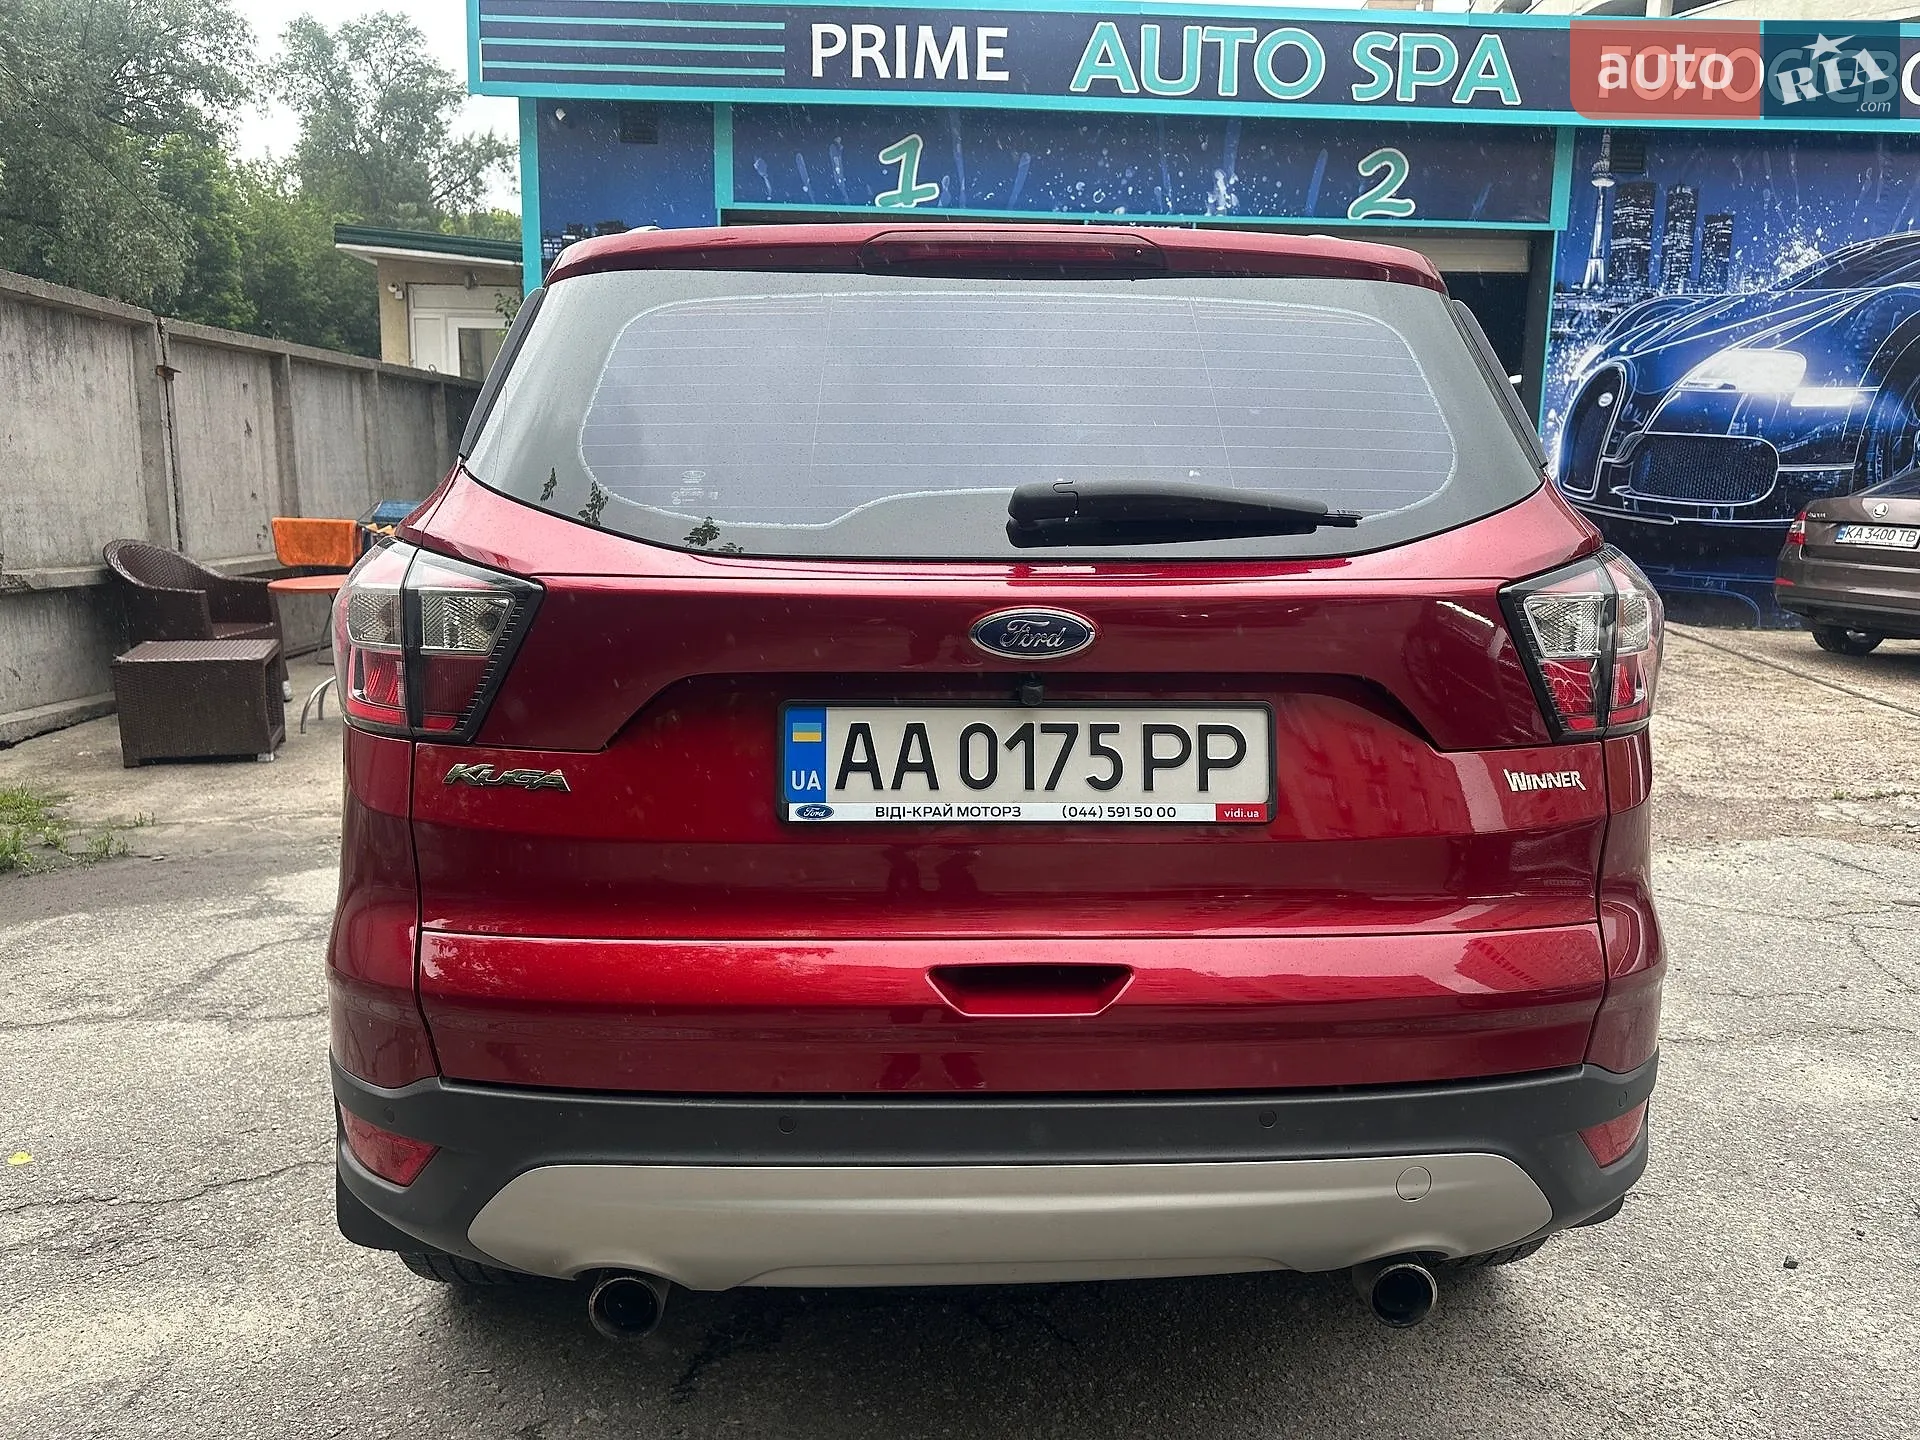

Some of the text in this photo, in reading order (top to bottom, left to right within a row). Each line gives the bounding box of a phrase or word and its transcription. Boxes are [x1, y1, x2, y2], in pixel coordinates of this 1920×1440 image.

[811, 21, 1521, 106] PRIME AUTO SPA
[876, 133, 940, 208] 1
[1347, 147, 1416, 220] 2
[1845, 526, 1862, 539] KA
[1865, 527, 1896, 540] 3400
[1899, 530, 1917, 543] TB
[1000, 619, 1066, 649] Ford
[834, 721, 1248, 792] AA 0175 PP
[791, 770, 821, 790] UA
[803, 806, 826, 818] Ford
[875, 803, 1022, 819] ВІДІ-КРАЙ МОТОРЗ
[1061, 805, 1177, 819] (044) 591 50 00
[1223, 807, 1260, 819] vidi.ua
